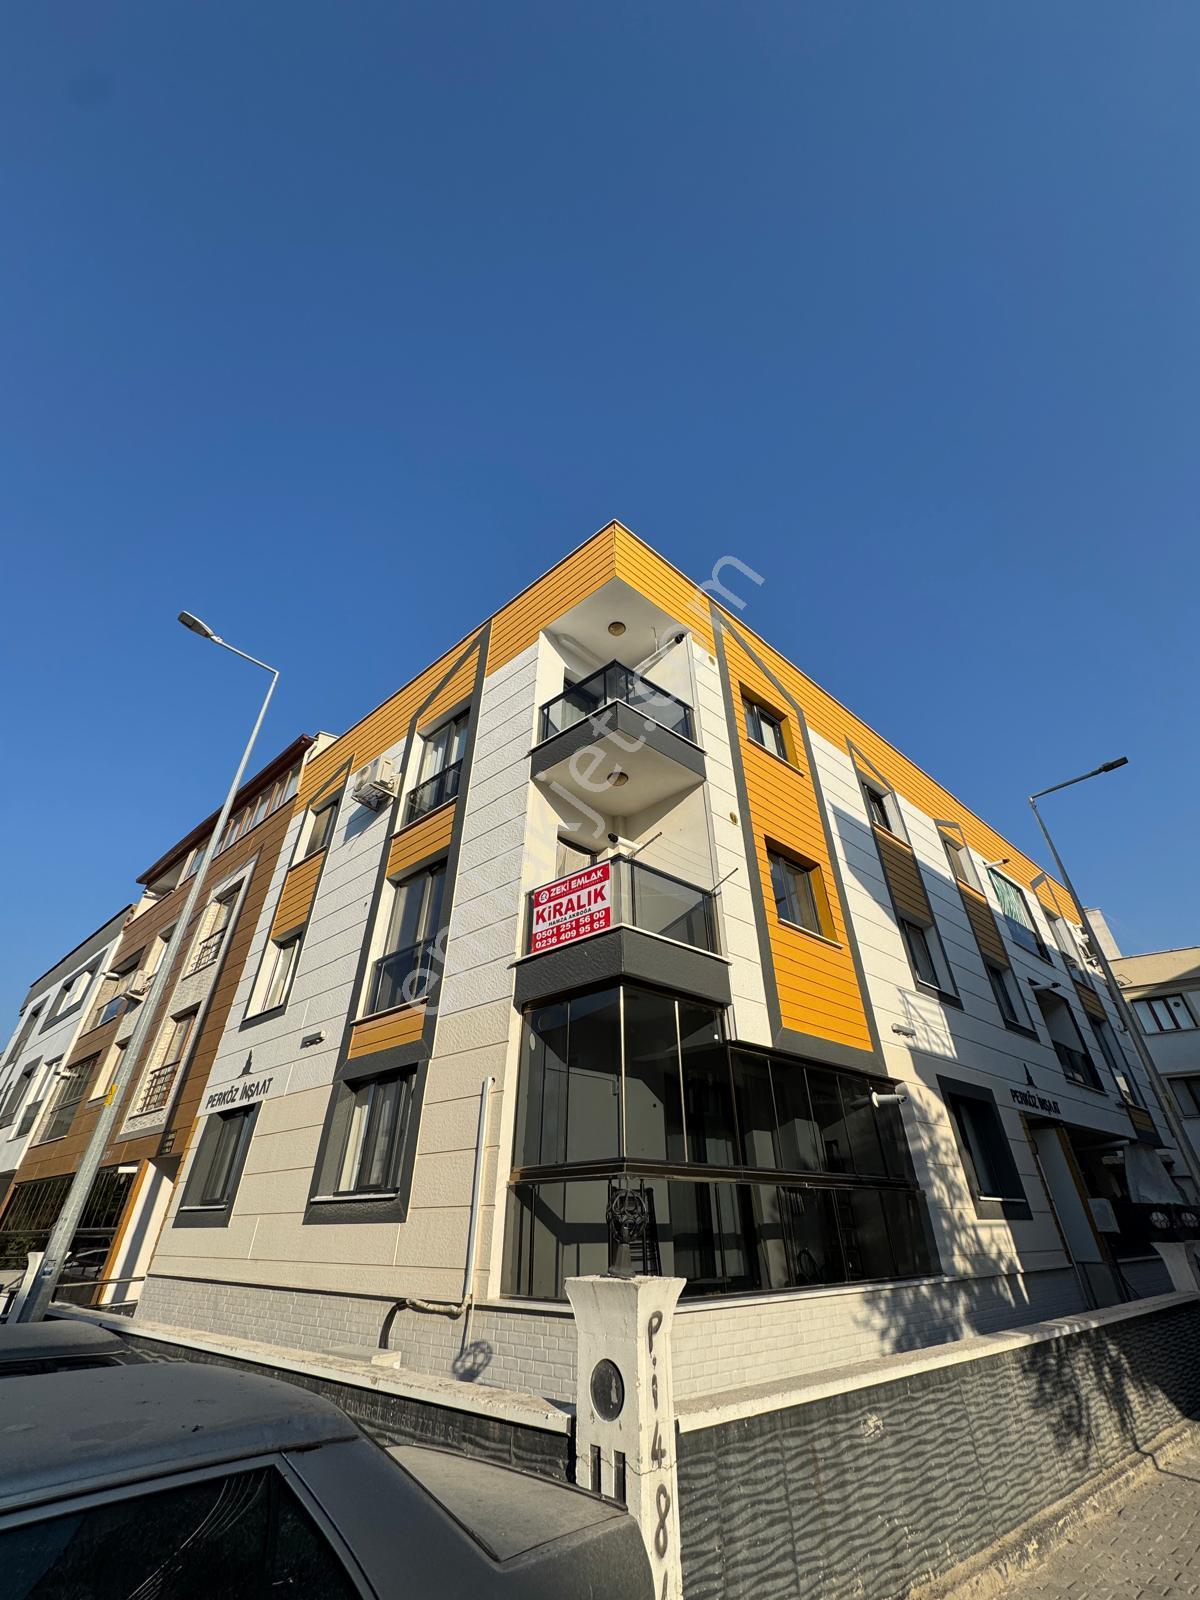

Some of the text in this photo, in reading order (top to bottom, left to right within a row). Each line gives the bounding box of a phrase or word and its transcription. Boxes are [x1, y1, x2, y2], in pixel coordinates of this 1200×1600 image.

[550, 881, 570, 897] ZEKİ
[571, 868, 603, 889] EMLAK
[535, 919, 605, 949] 0236 409 95 65
[536, 910, 605, 940] 0501 251 56 00
[205, 1085, 240, 1109] PERKÖZ
